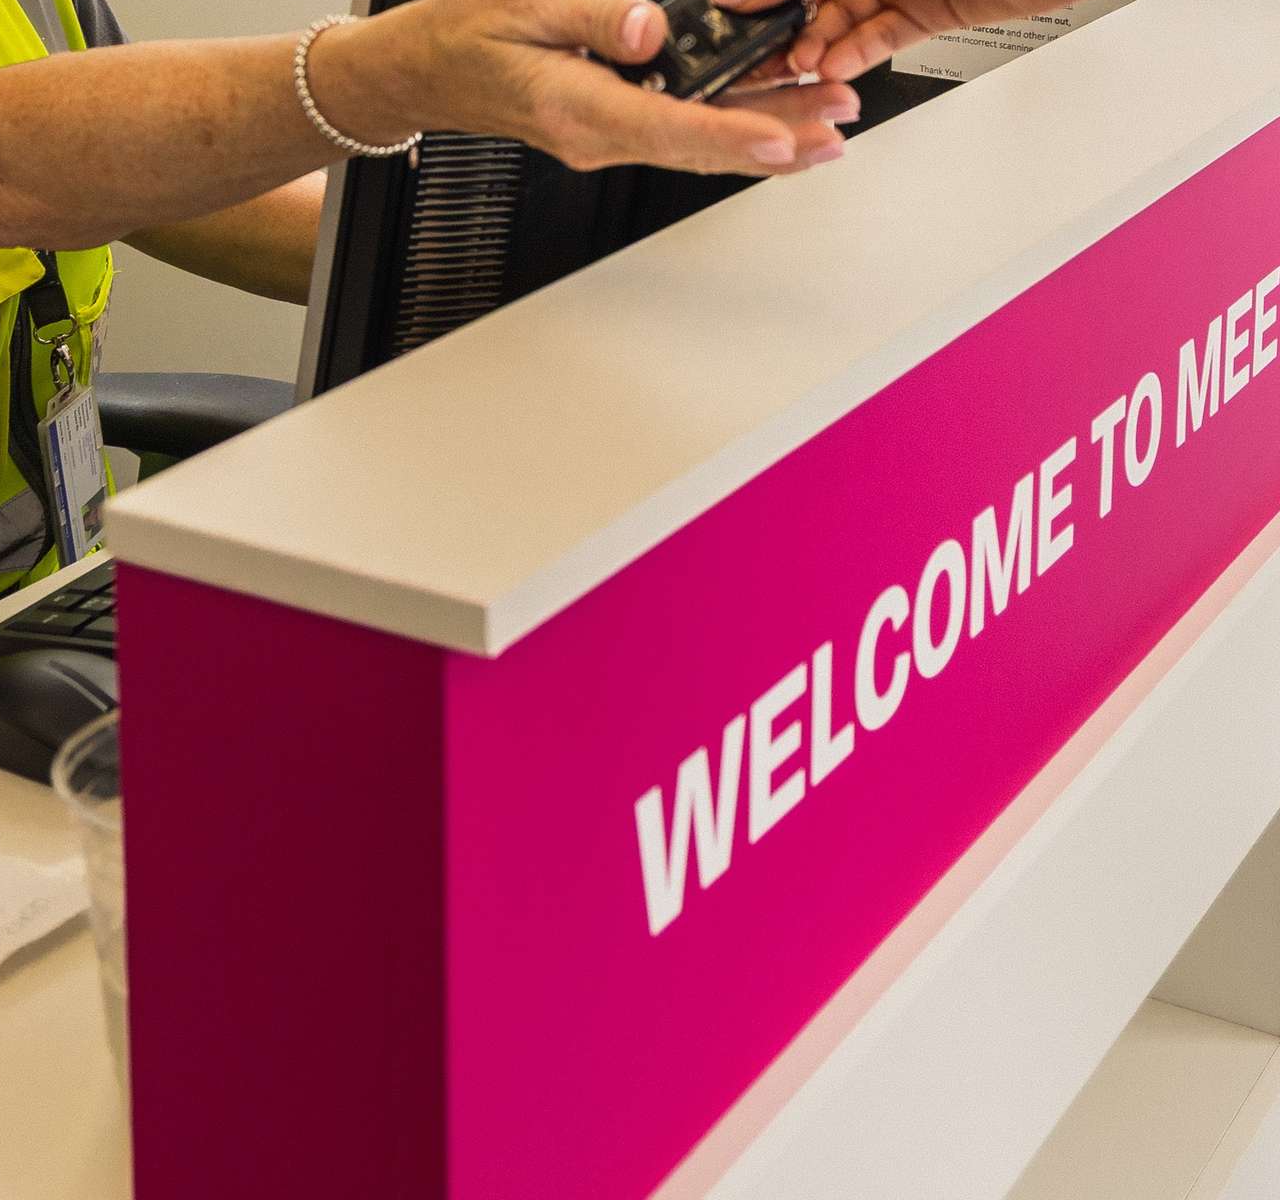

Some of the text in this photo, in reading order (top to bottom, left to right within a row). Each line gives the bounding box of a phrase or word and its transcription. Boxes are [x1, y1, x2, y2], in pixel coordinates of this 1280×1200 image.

[1006, 29, 1021, 38] and
[1023, 30, 1045, 41] other
[962, 36, 997, 48] incorrect
[920, 64, 962, 79] Thank You!
[634, 435, 1078, 936] WELCOME
[1091, 372, 1163, 520] TO
